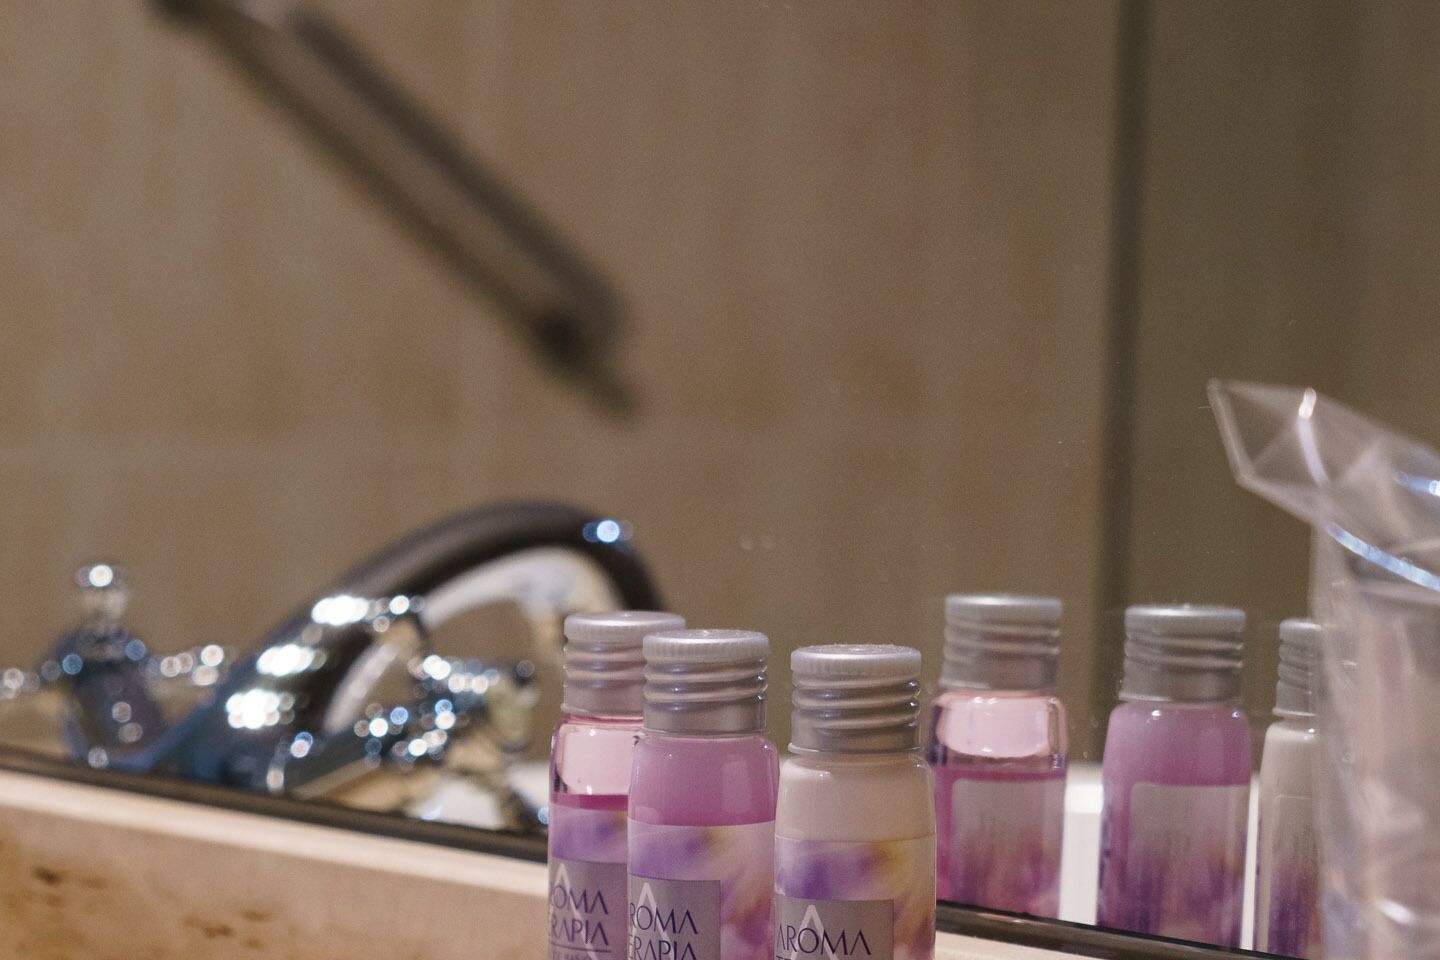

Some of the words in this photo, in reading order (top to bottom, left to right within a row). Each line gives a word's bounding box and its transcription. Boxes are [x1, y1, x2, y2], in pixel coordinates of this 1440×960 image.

[551, 884, 609, 915] OMA
[551, 913, 609, 946] RAPIA
[629, 902, 699, 935] ROMA
[776, 924, 873, 956] AROMA
